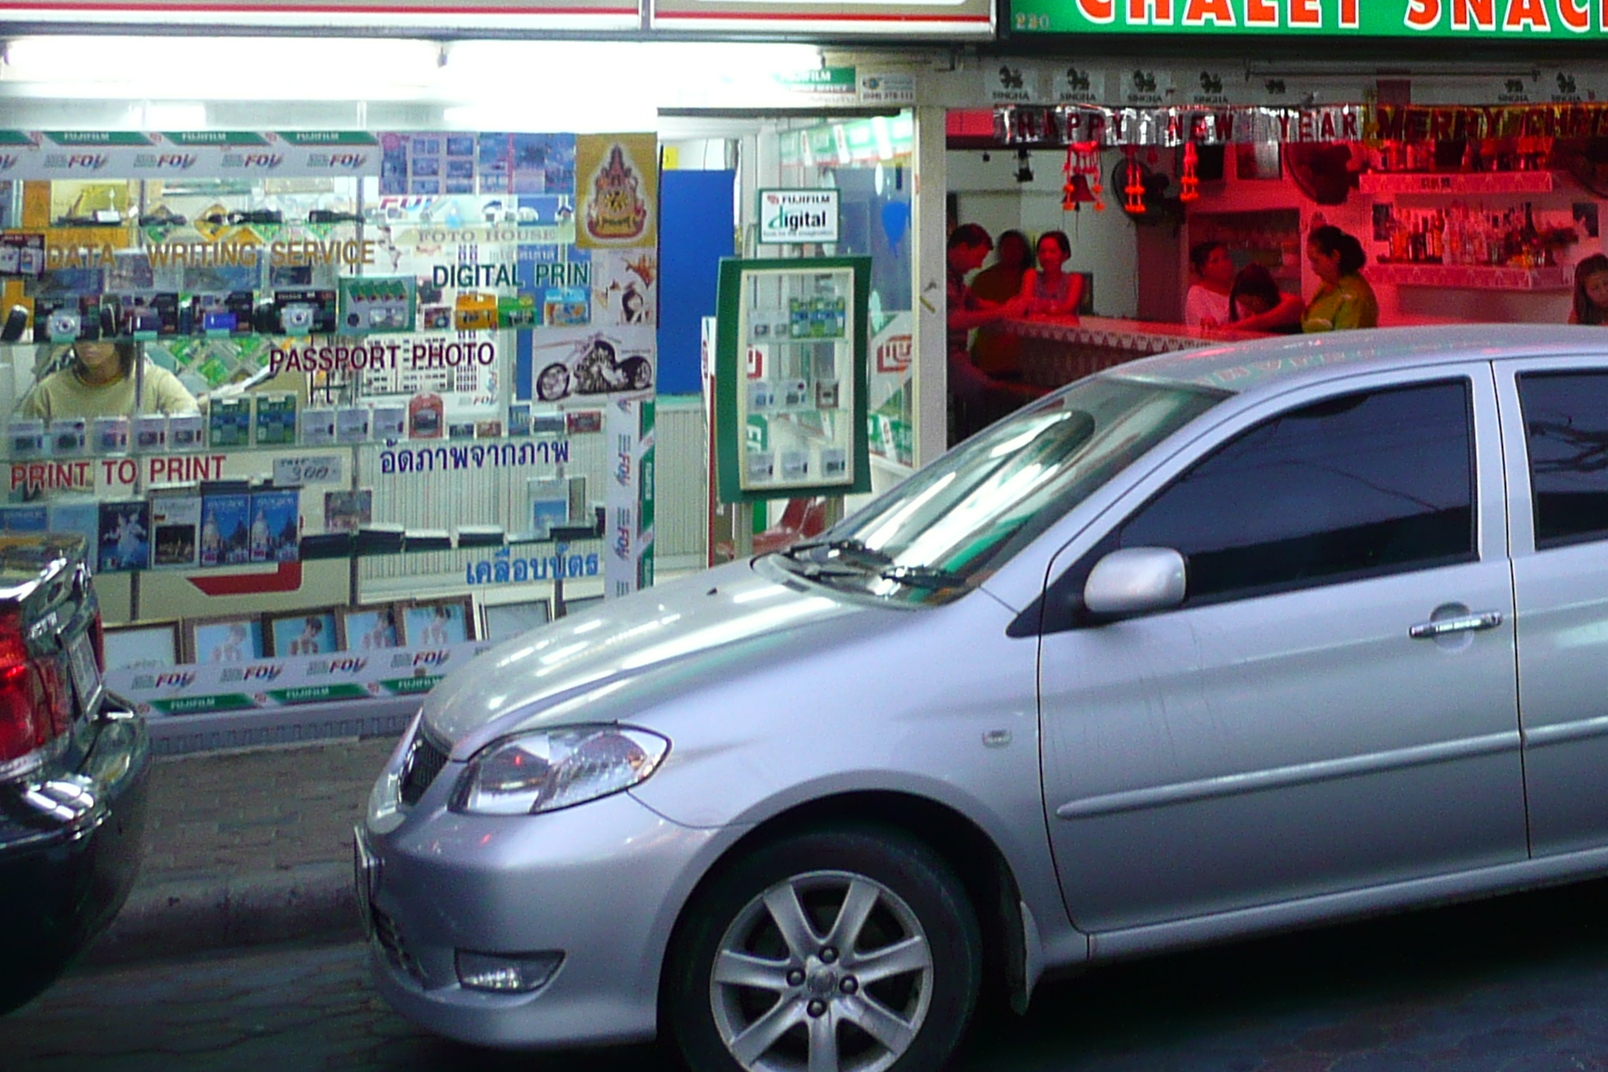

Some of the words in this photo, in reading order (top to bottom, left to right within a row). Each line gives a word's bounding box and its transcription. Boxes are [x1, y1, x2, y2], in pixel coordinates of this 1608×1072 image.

[992, 91, 1030, 102] SINGHA
[1060, 92, 1097, 103] SINGHA
[1017, 108, 1125, 143] HAPPY
[1167, 109, 1235, 142] NEW
[1277, 110, 1358, 143] YEAR
[782, 194, 830, 205] FUJIFILM
[768, 205, 826, 230] digital
[417, 229, 476, 243] FOTO
[485, 228, 557, 242] HOUSE
[48, 241, 117, 270] DATA
[147, 240, 258, 268] WRITING
[270, 239, 375, 266] SERVICE
[432, 263, 524, 289] DIGITAL
[270, 344, 402, 373] PASSPORT
[411, 342, 496, 367] PHOTO
[11, 462, 90, 490] PRINT
[102, 459, 138, 485] TO
[149, 455, 227, 483] PRINT
